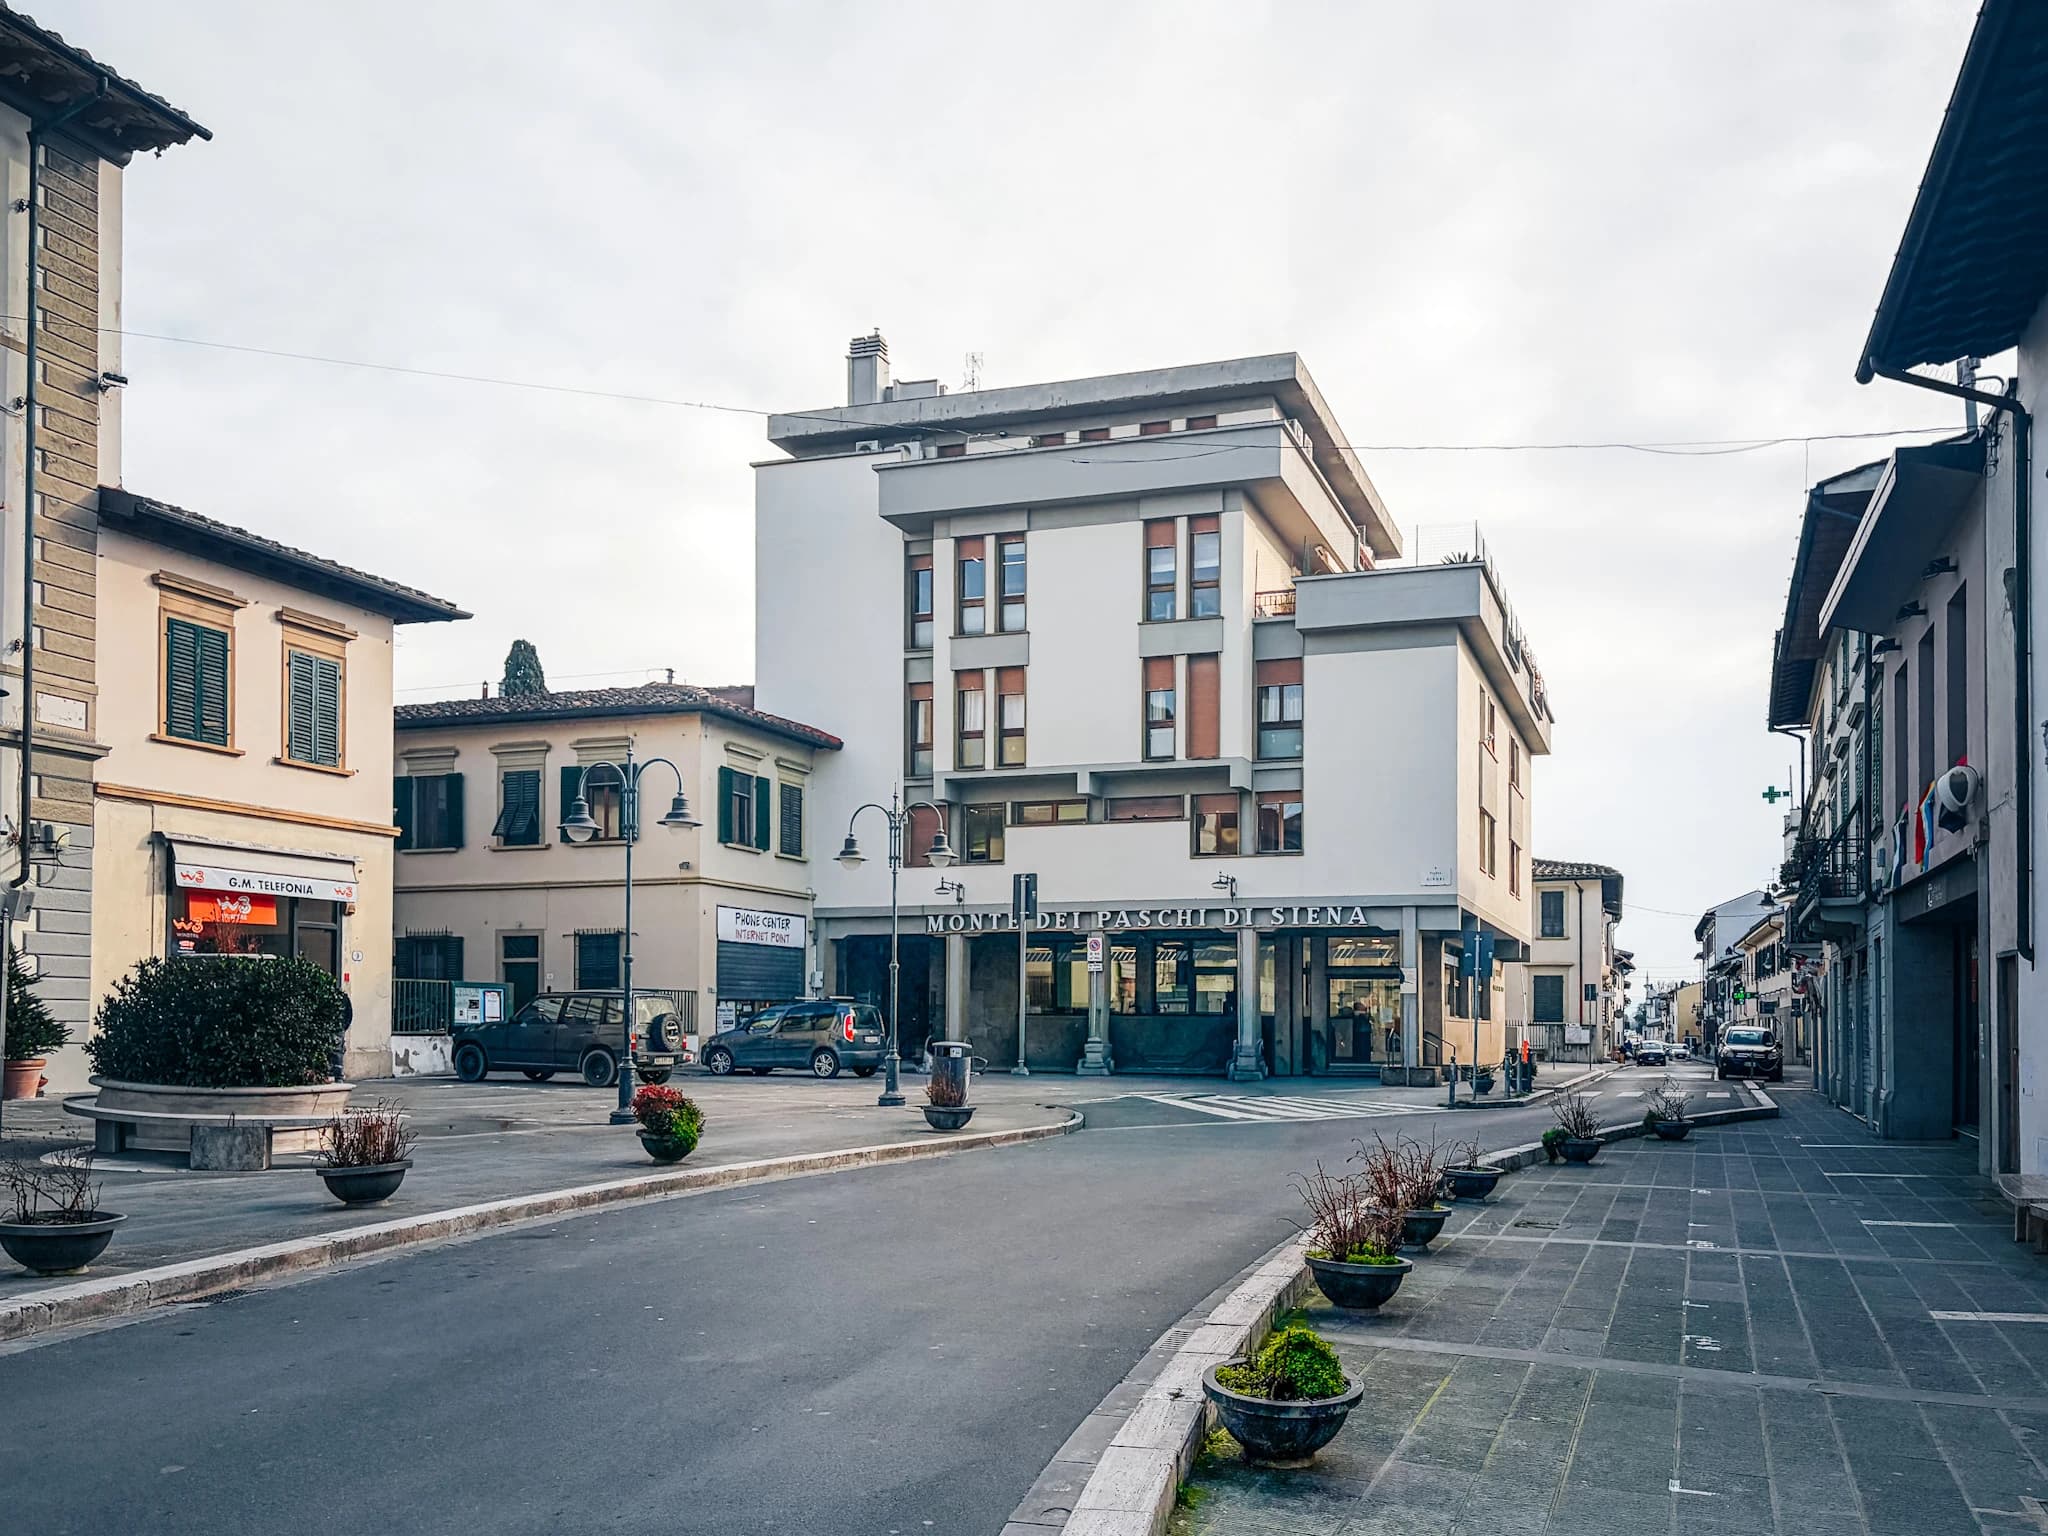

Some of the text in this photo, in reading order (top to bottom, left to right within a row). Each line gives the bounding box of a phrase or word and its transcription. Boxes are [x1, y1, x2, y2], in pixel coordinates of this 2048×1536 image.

[229, 877, 314, 895] G.M. TELEFONIA
[735, 912, 791, 930] PHONE CENTER
[1036, 911, 1081, 930] DEI
[1097, 909, 1207, 930] PASCHI
[1224, 908, 1253, 926] DI
[1270, 906, 1369, 926] SIENA
[735, 928, 790, 943] INTERNET POINT
